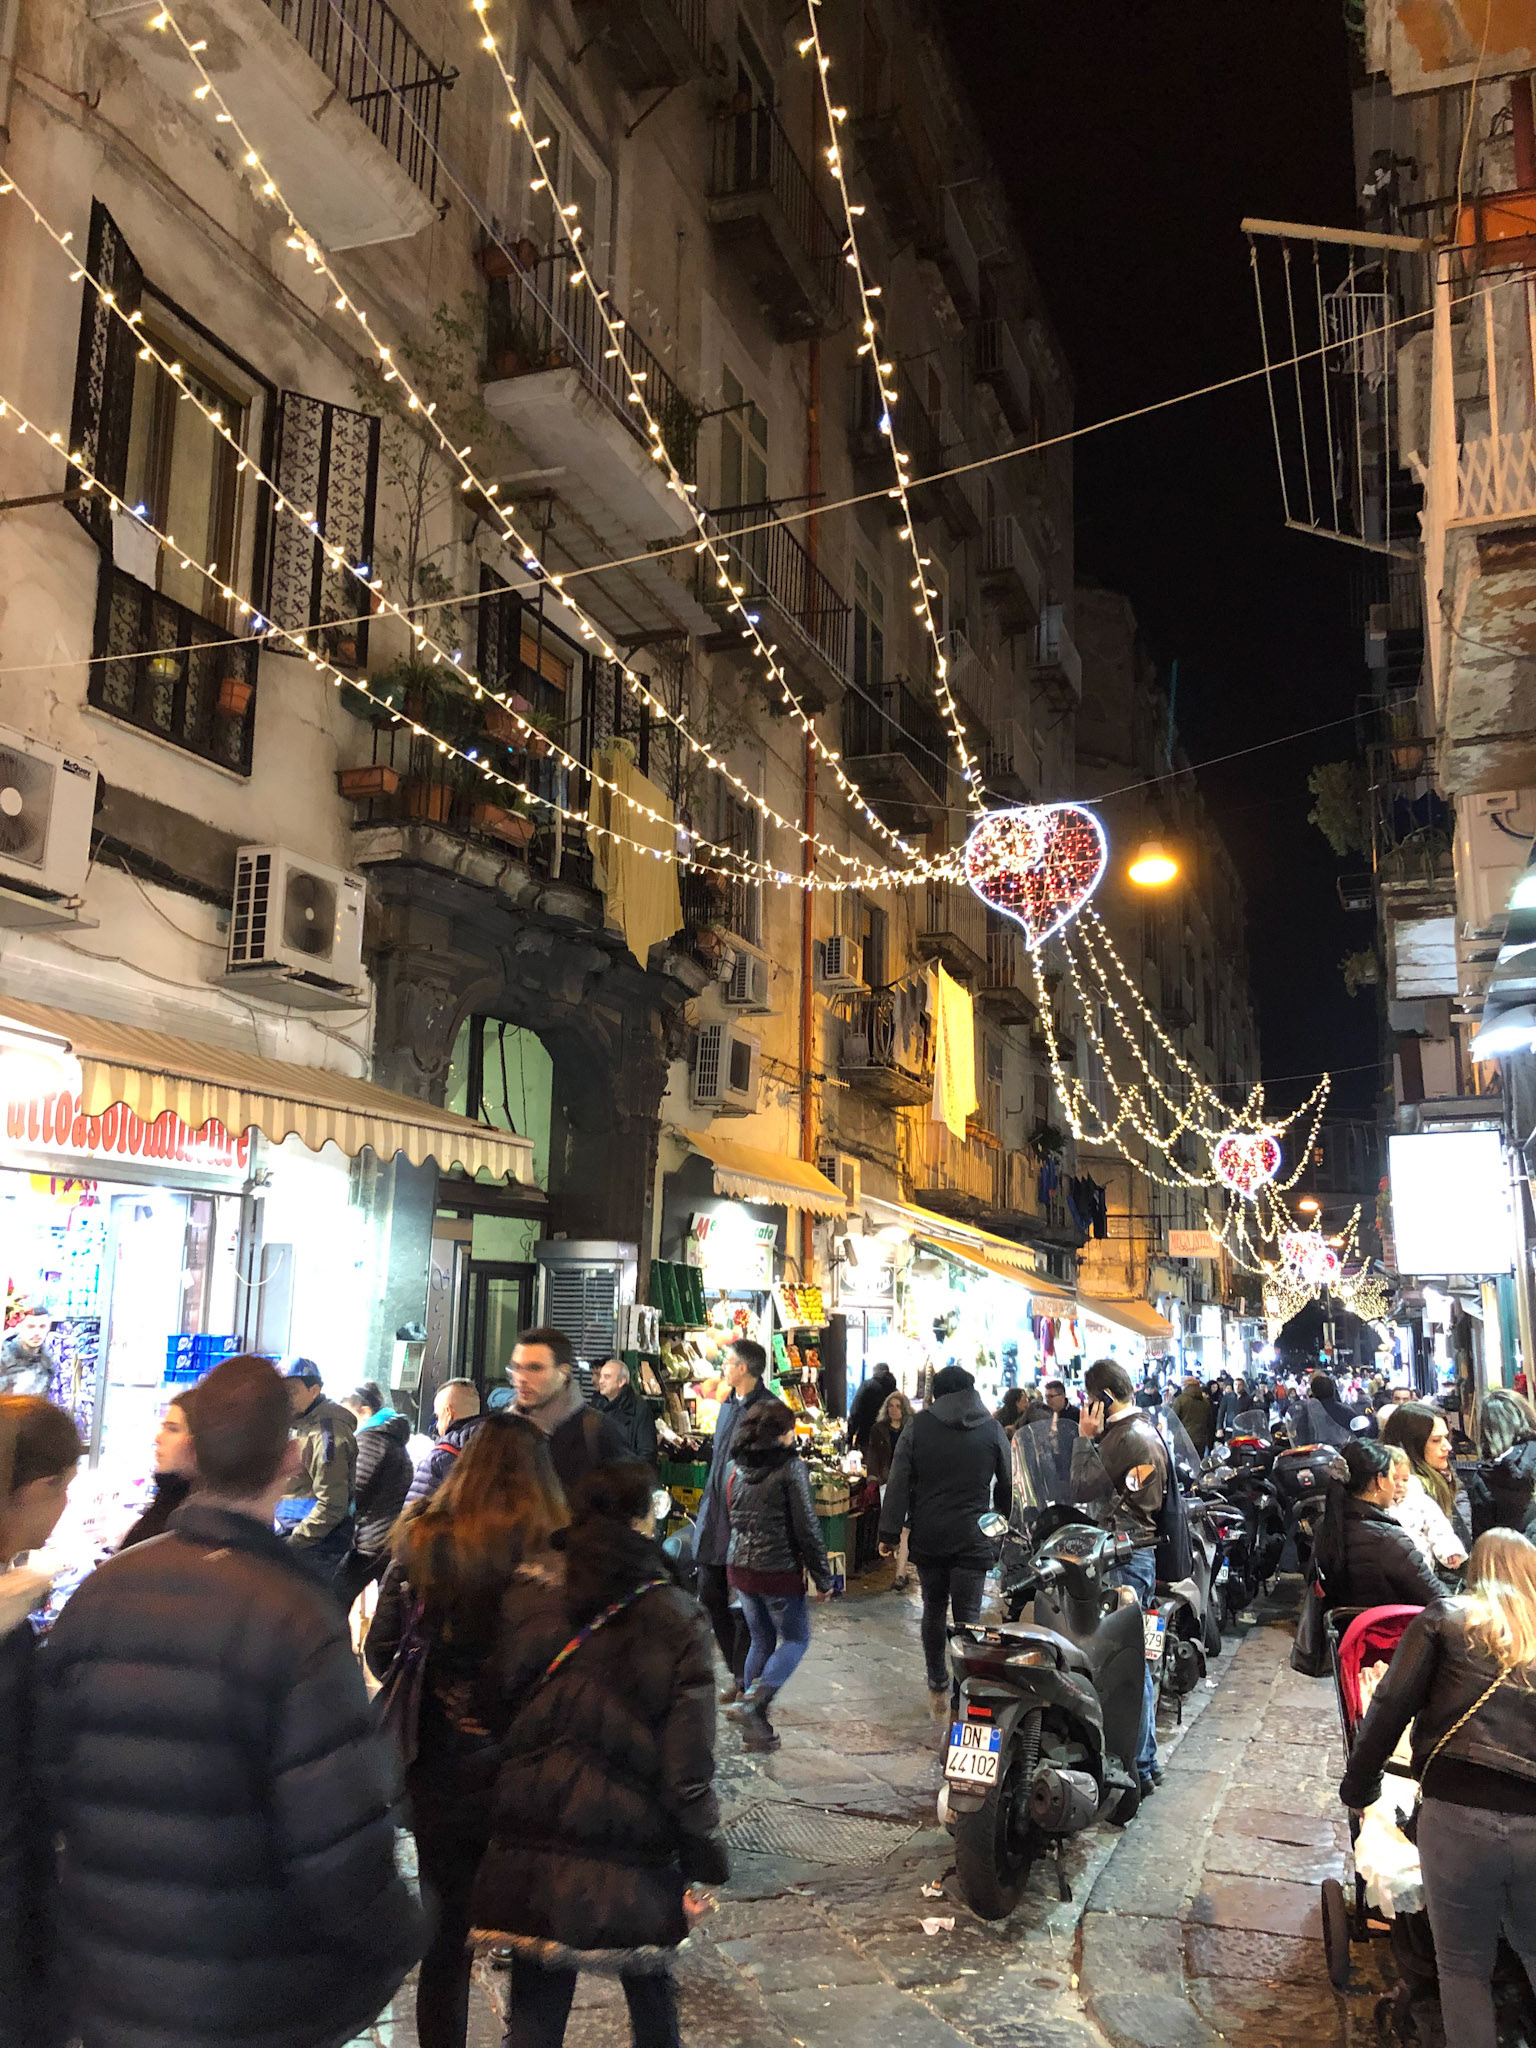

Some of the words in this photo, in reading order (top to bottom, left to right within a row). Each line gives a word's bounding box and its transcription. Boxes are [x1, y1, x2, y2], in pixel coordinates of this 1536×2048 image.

[63, 759, 91, 778] McQuay
[962, 1725, 982, 1748] DN
[948, 1752, 996, 1778] 44102
